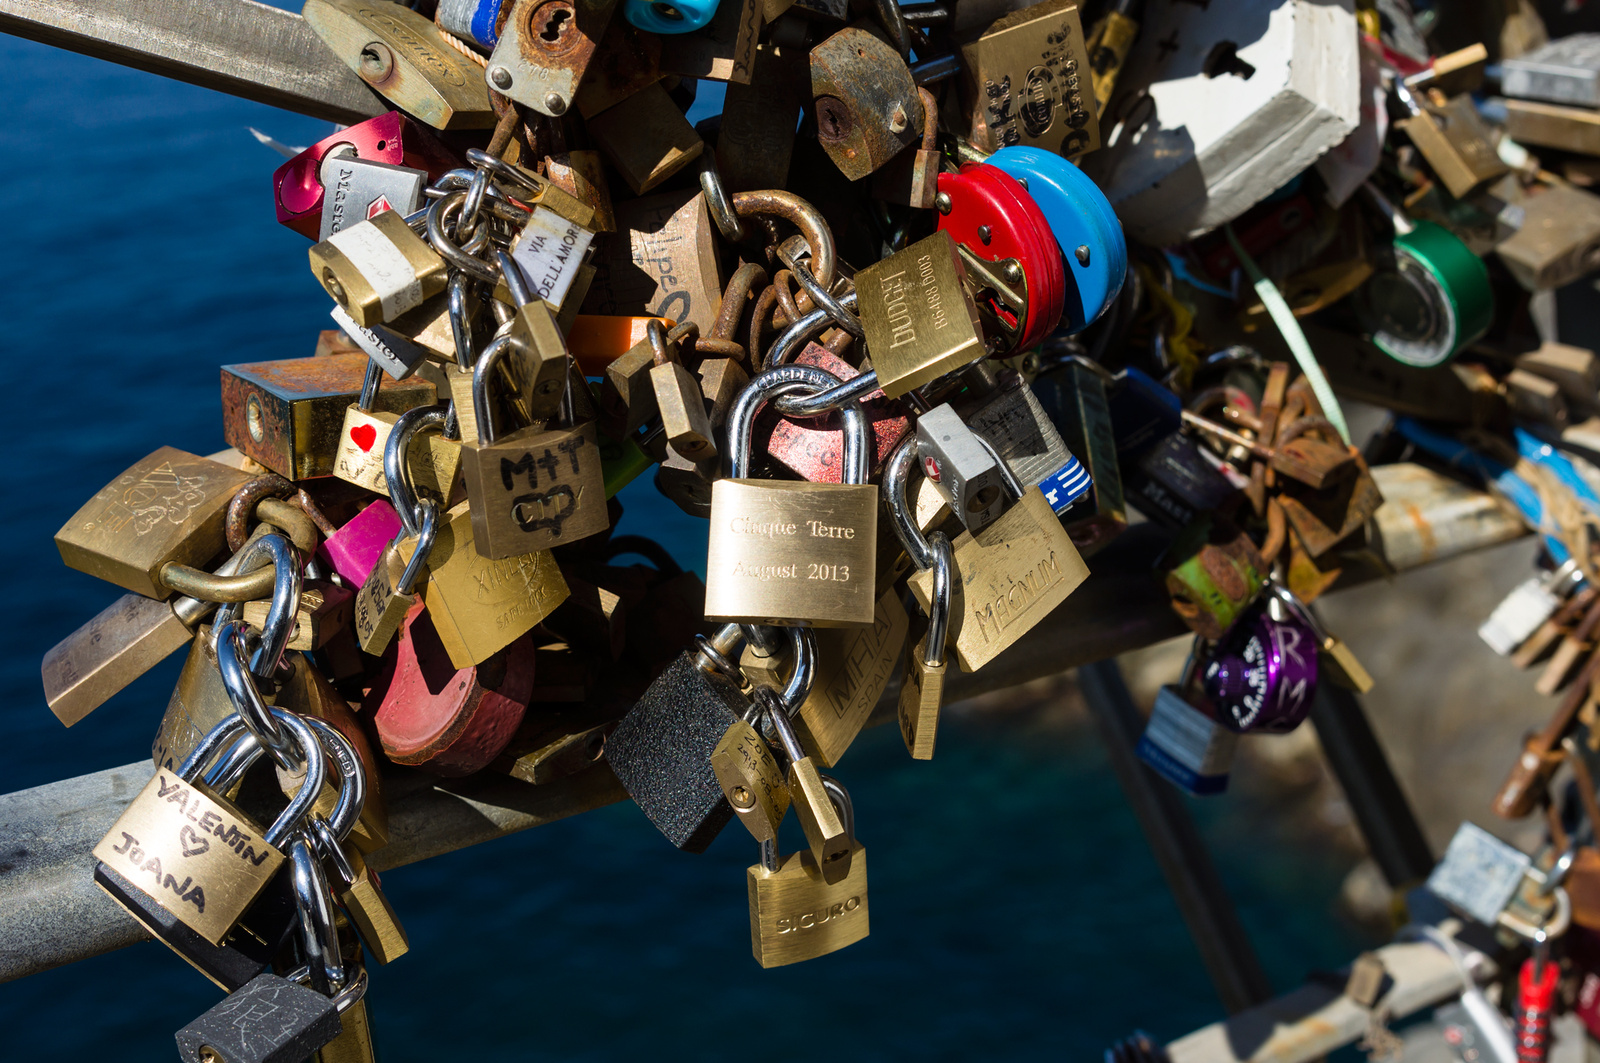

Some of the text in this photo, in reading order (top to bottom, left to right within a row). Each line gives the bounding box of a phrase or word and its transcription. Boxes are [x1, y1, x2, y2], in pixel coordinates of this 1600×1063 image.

[335, 168, 353, 238] Maste
[527, 233, 548, 256] VIA
[353, 320, 403, 365] aster
[730, 516, 855, 540] Cinque Terre
[733, 562, 850, 582] August 2013
[975, 550, 1062, 645] MAGNUM
[856, 651, 893, 714] SPAIN
[744, 733, 771, 766] ZOE
[159, 776, 269, 866] VALENTIN
[112, 831, 205, 913] JOANA
[775, 895, 860, 934] SICURO
